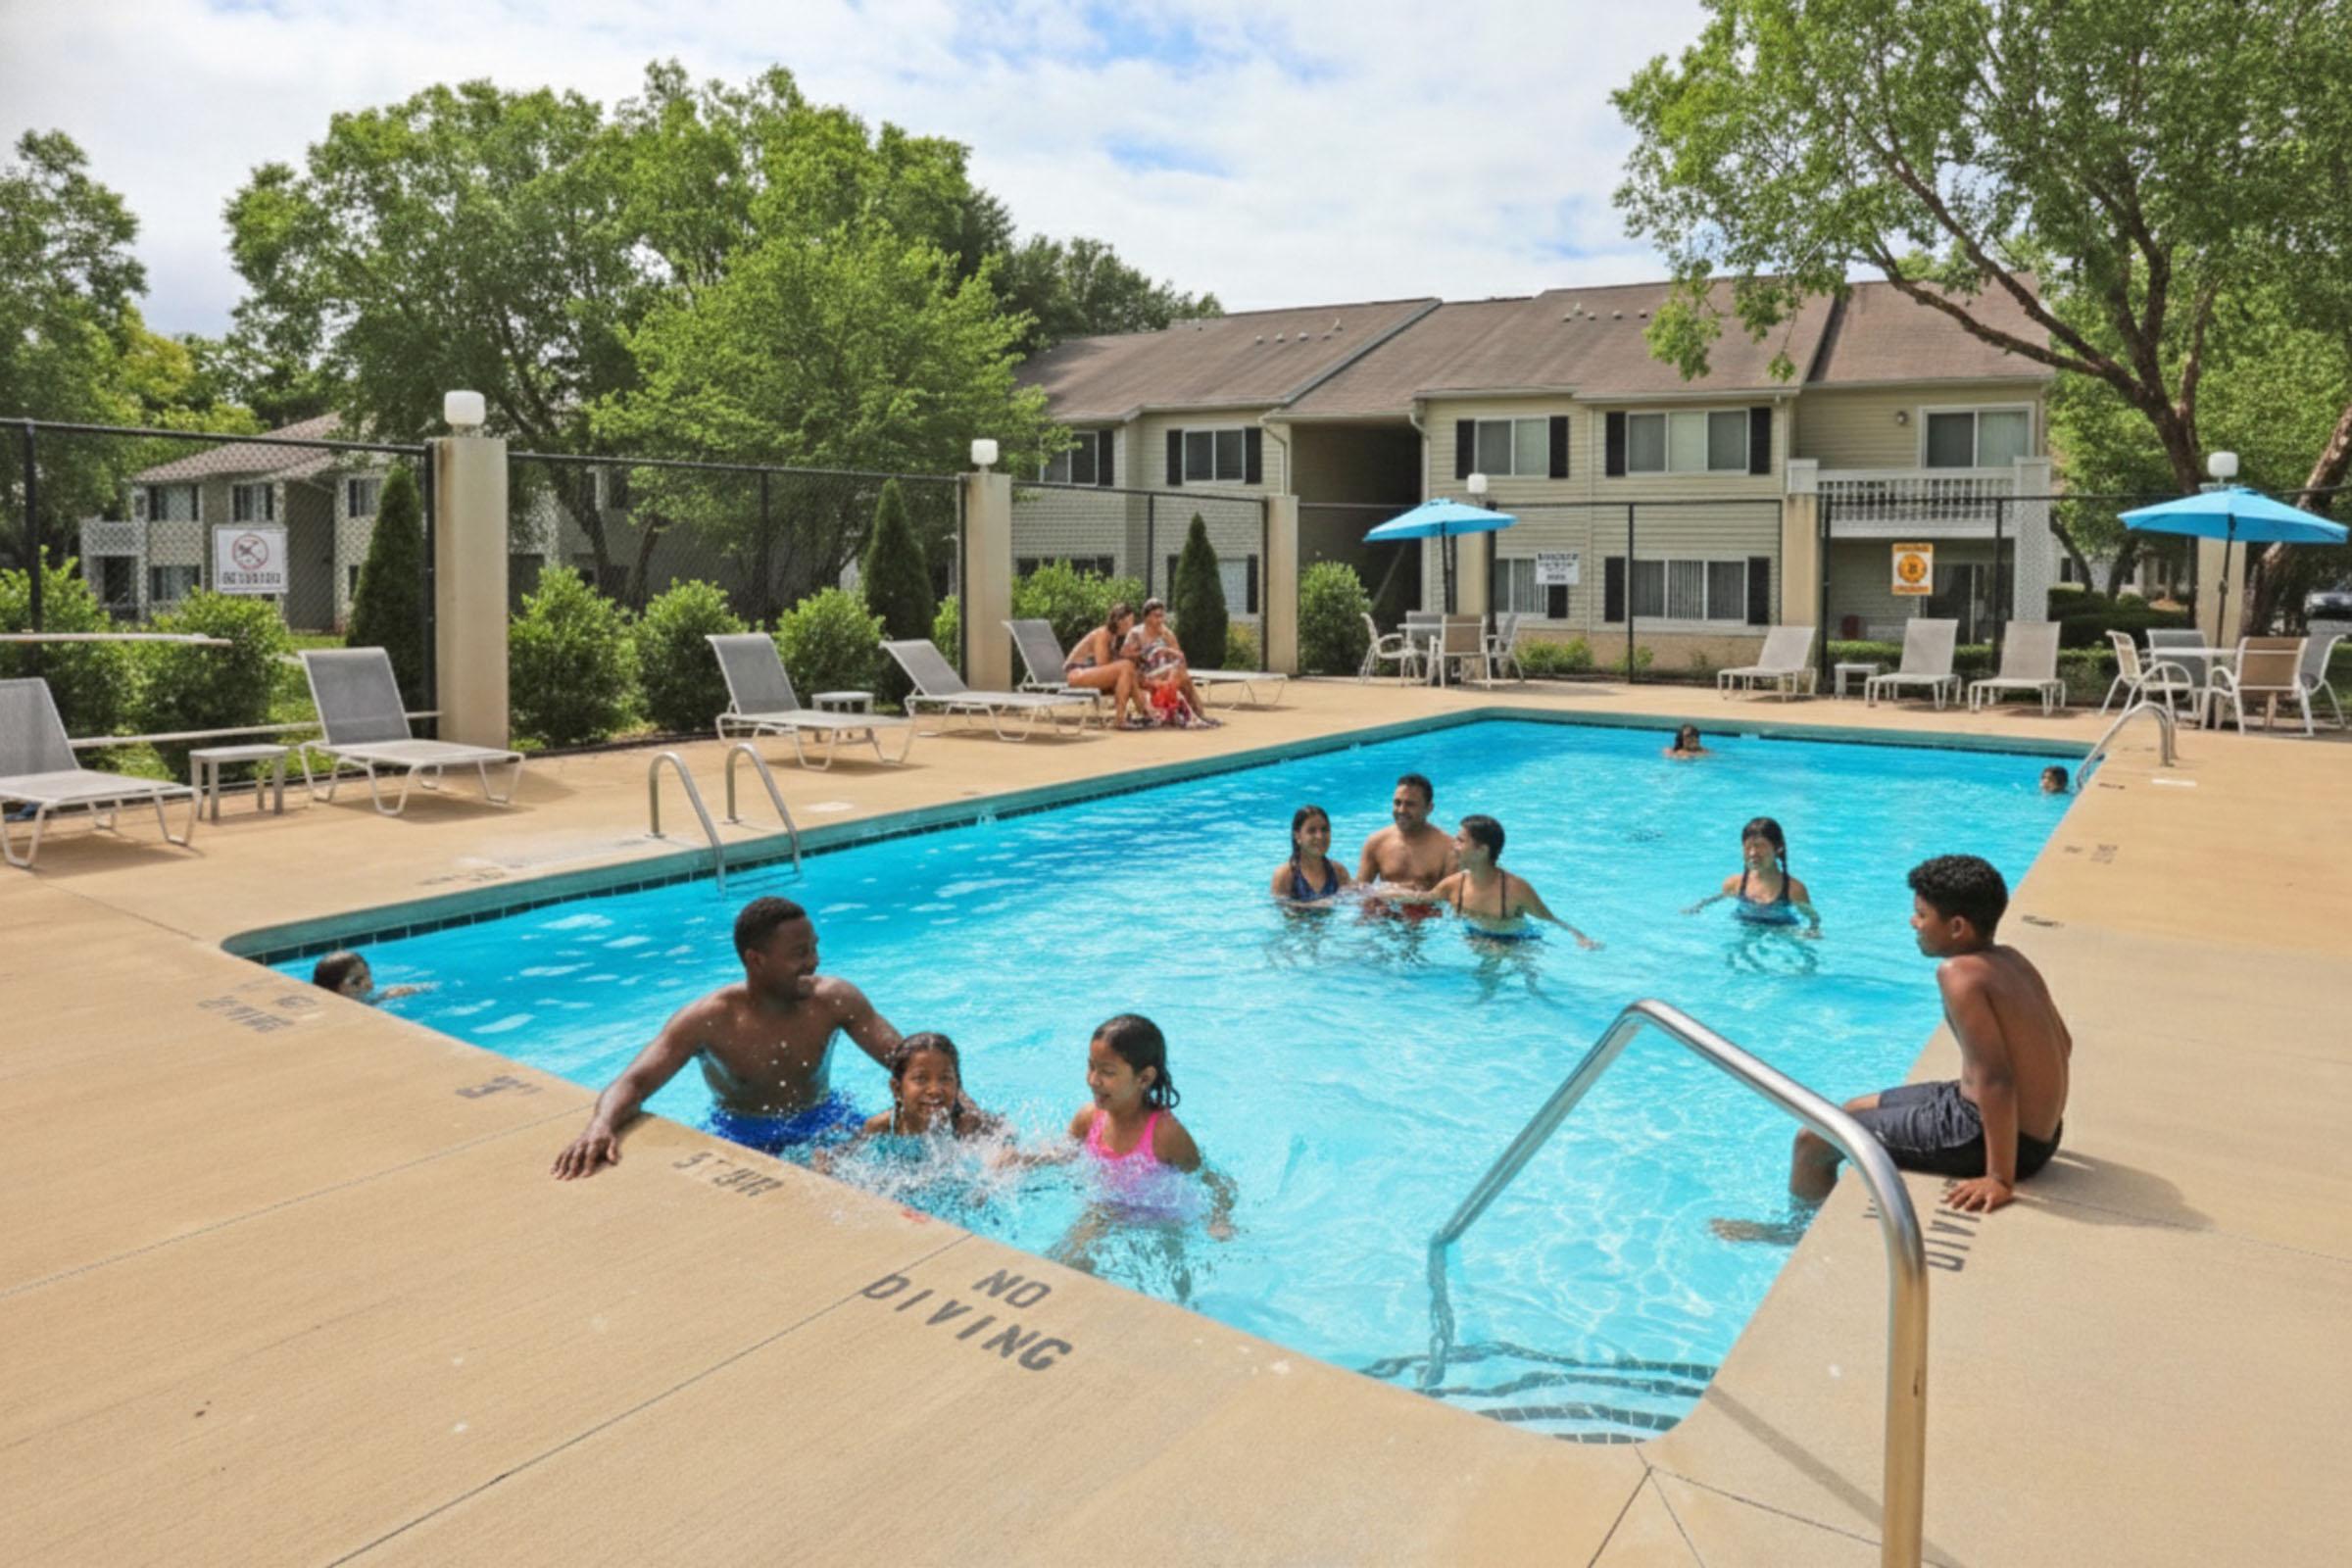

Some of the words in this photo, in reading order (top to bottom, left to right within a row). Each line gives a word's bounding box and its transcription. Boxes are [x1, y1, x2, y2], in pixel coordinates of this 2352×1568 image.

[1924, 1179, 1982, 1272] DIVI
[861, 1273, 1073, 1372] DIVING
[971, 1268, 1052, 1309] NO
